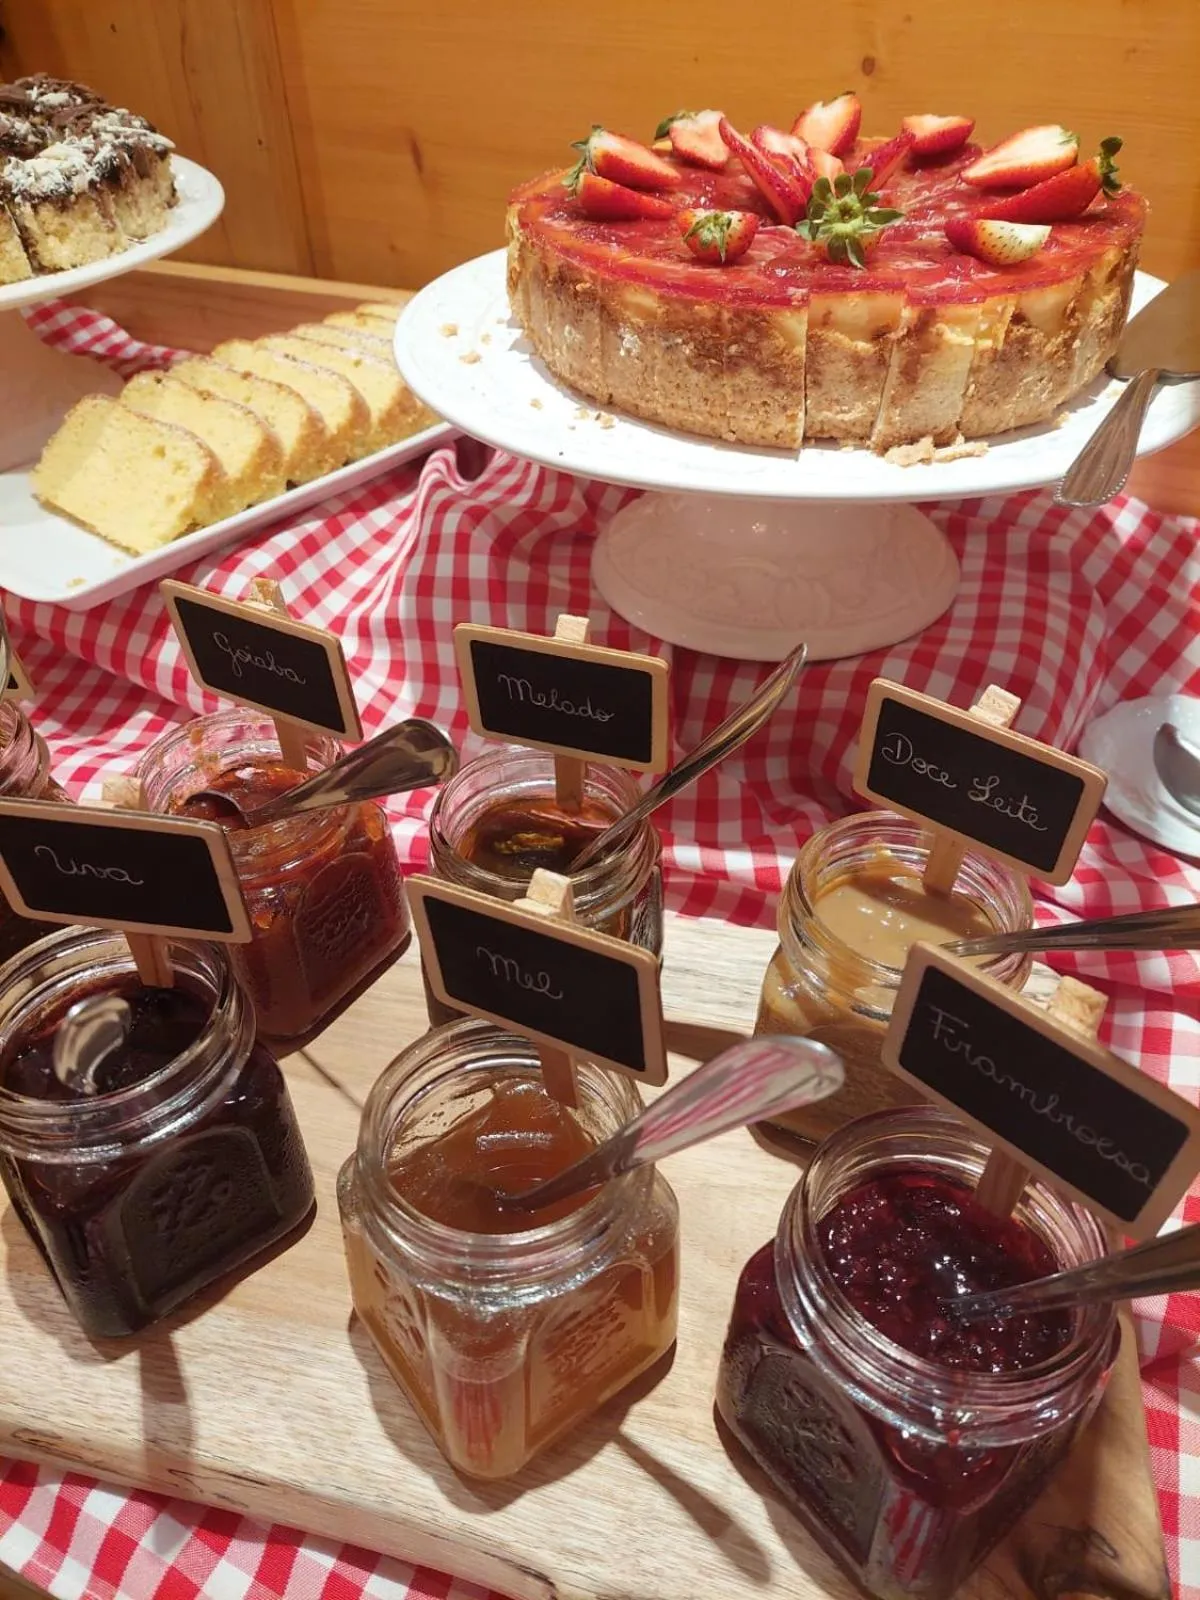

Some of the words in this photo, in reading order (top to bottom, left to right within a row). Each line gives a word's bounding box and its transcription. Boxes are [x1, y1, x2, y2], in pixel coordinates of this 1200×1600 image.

[213, 631, 307, 685] Goiaba
[498, 673, 615, 723] Melado
[881, 732, 958, 790] Doce
[969, 774, 1048, 832] Leite
[34, 845, 145, 888] Uva
[477, 946, 564, 1000] Mel
[926, 1005, 1155, 1190] Framboesa
